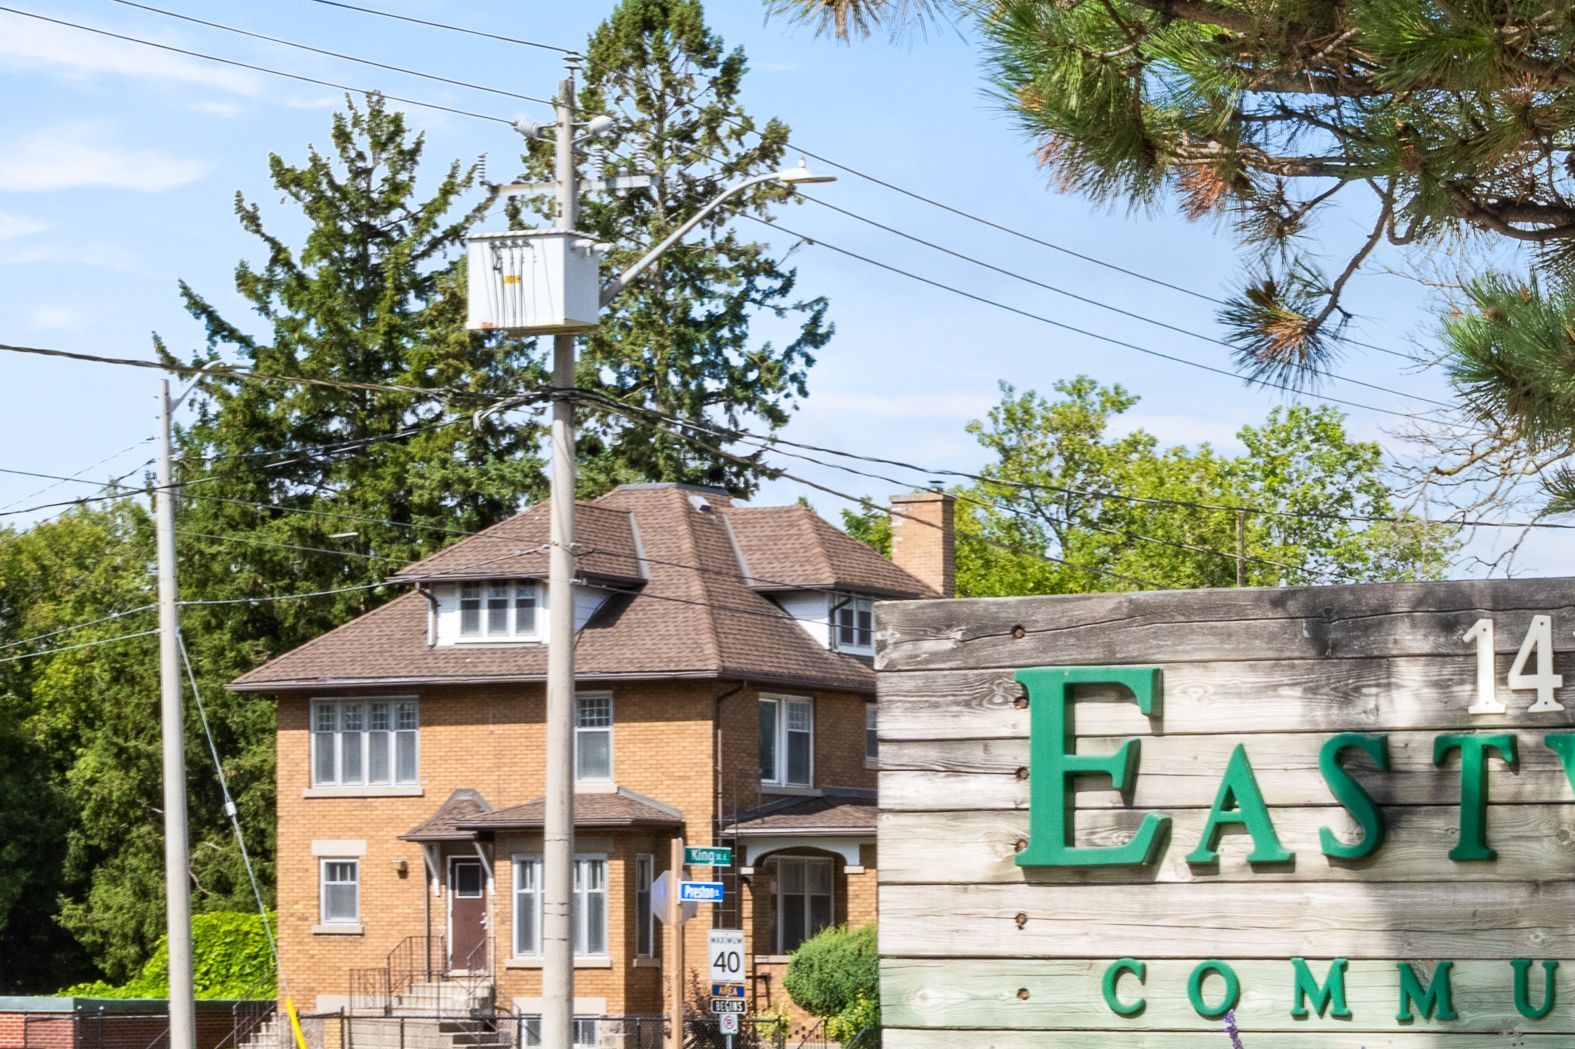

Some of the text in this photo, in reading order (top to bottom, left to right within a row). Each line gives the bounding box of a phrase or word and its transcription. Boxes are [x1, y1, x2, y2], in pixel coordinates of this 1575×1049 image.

[691, 849, 714, 864] King
[684, 885, 714, 898] Preston
[713, 951, 741, 973] 40
[718, 986, 739, 997] AREA
[715, 1001, 743, 1012] BEGINS
